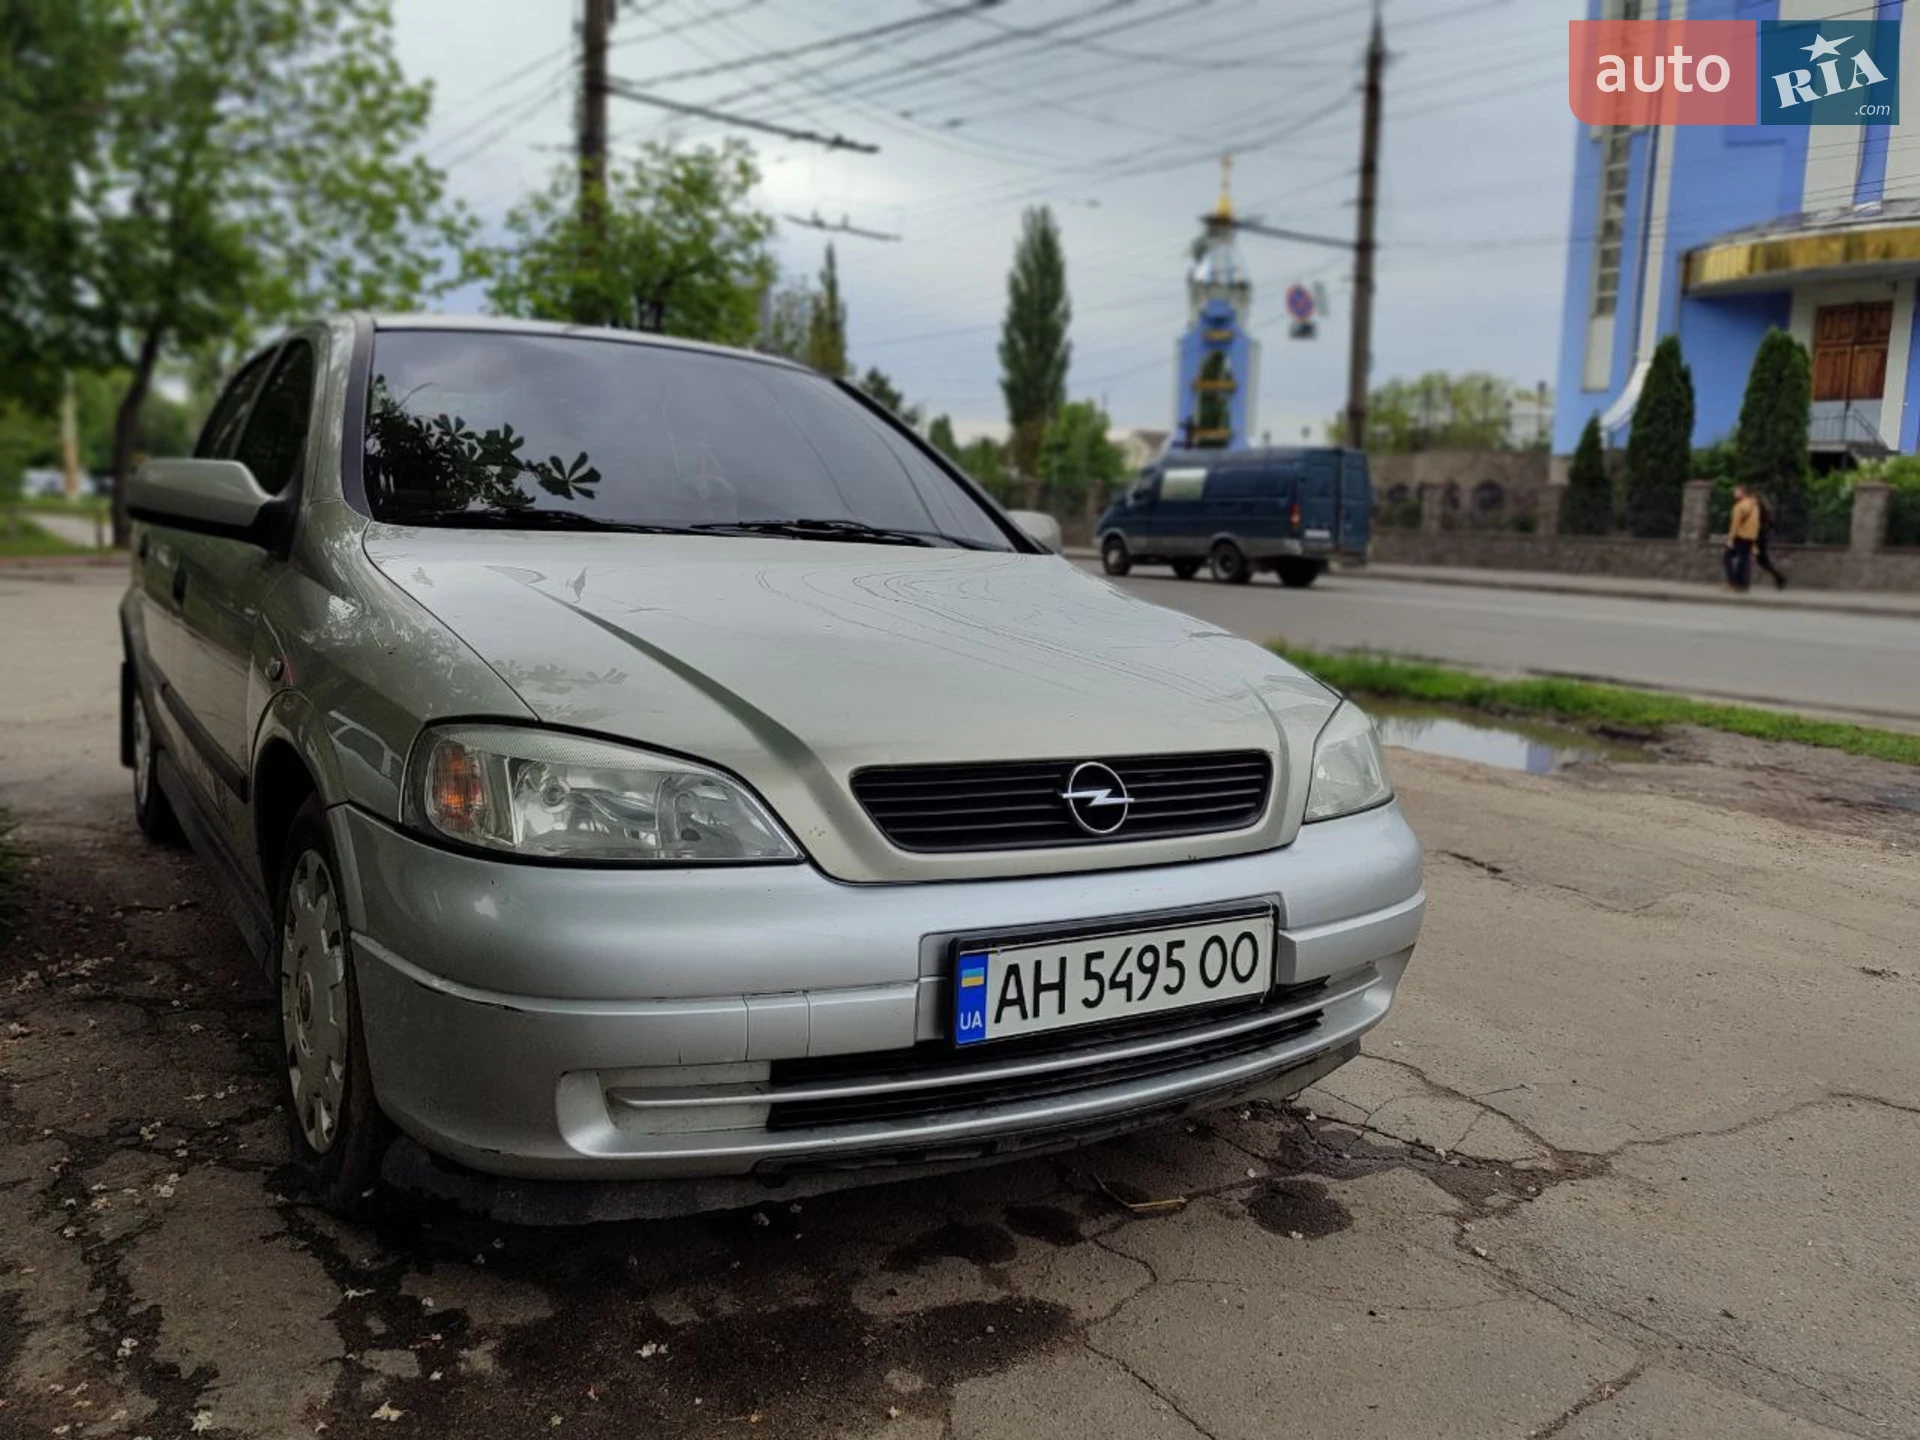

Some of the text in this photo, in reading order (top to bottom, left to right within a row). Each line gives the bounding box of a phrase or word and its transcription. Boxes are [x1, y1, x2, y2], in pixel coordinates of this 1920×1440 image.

[993, 931, 1259, 1024] AH 5495 OO
[960, 1009, 983, 1030] UA
